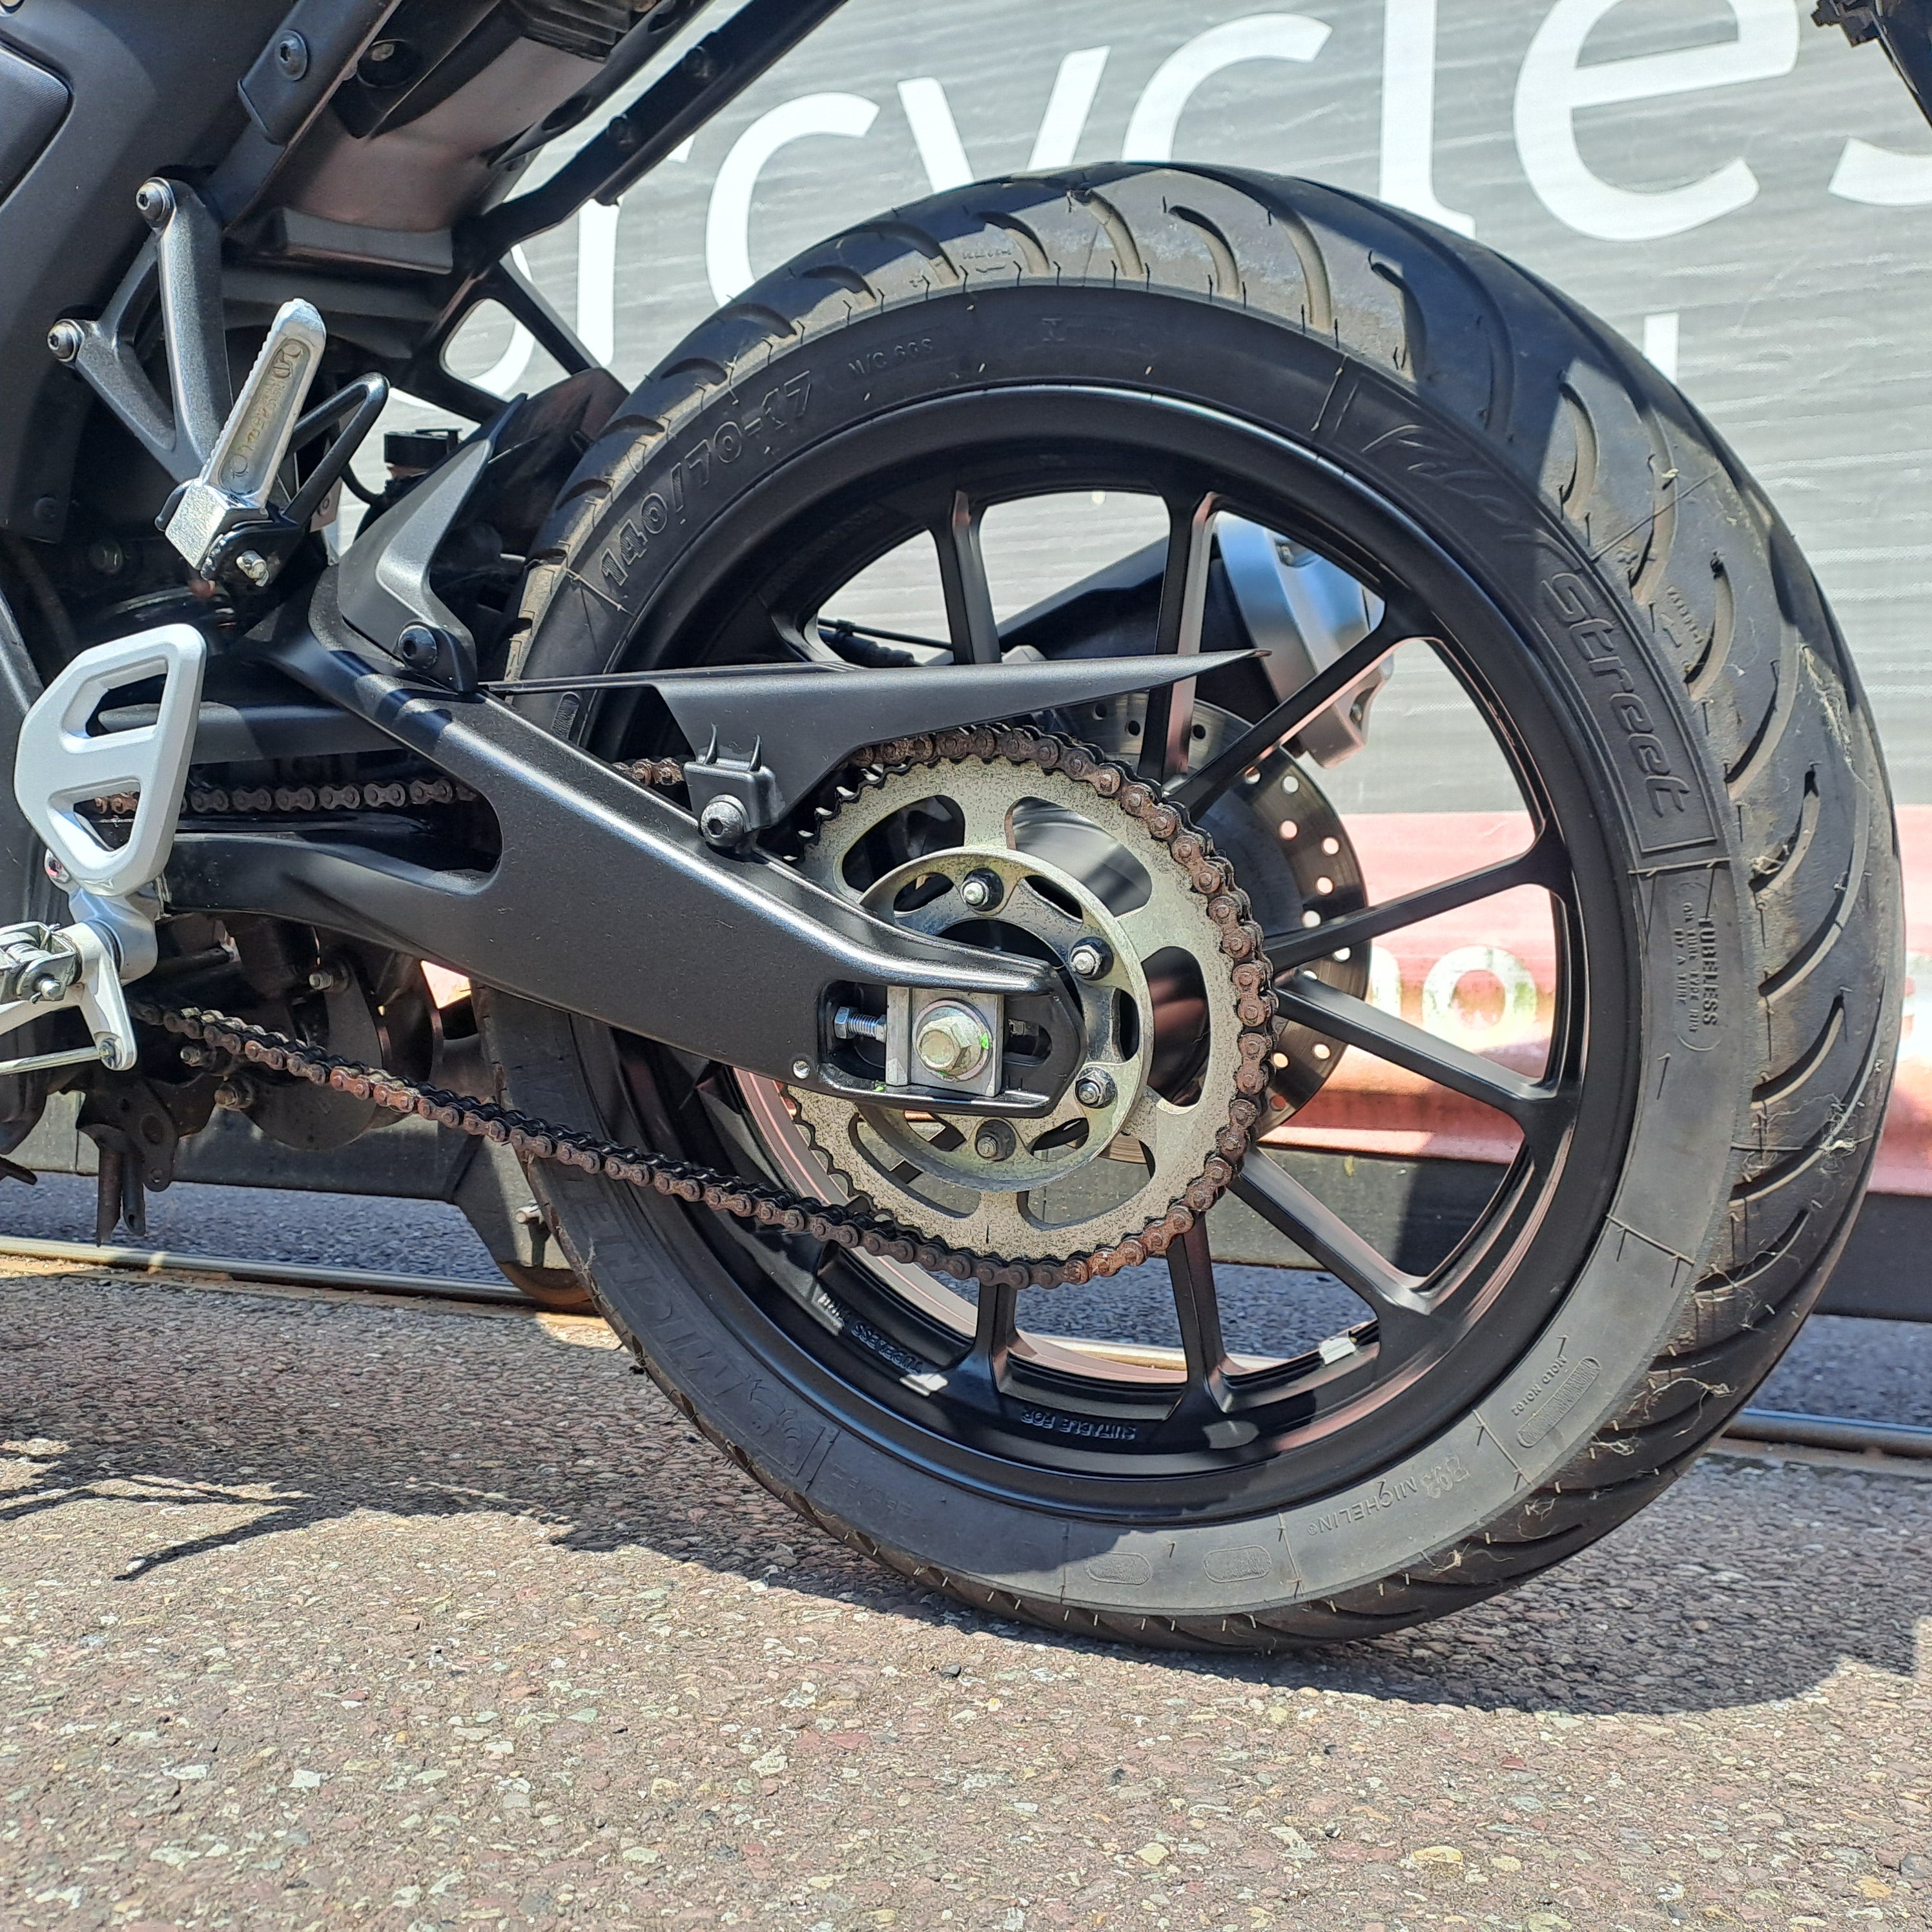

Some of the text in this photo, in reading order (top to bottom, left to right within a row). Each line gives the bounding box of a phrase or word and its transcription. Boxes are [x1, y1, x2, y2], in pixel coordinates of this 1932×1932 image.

[600, 368, 812, 586] 140/70-17
[1539, 570, 1690, 817] Street
[1698, 915, 1718, 1025] TUBELESS
[1020, 1409, 1136, 1439] SUITABLE FOR
[1541, 1354, 1568, 1386] MOLD
